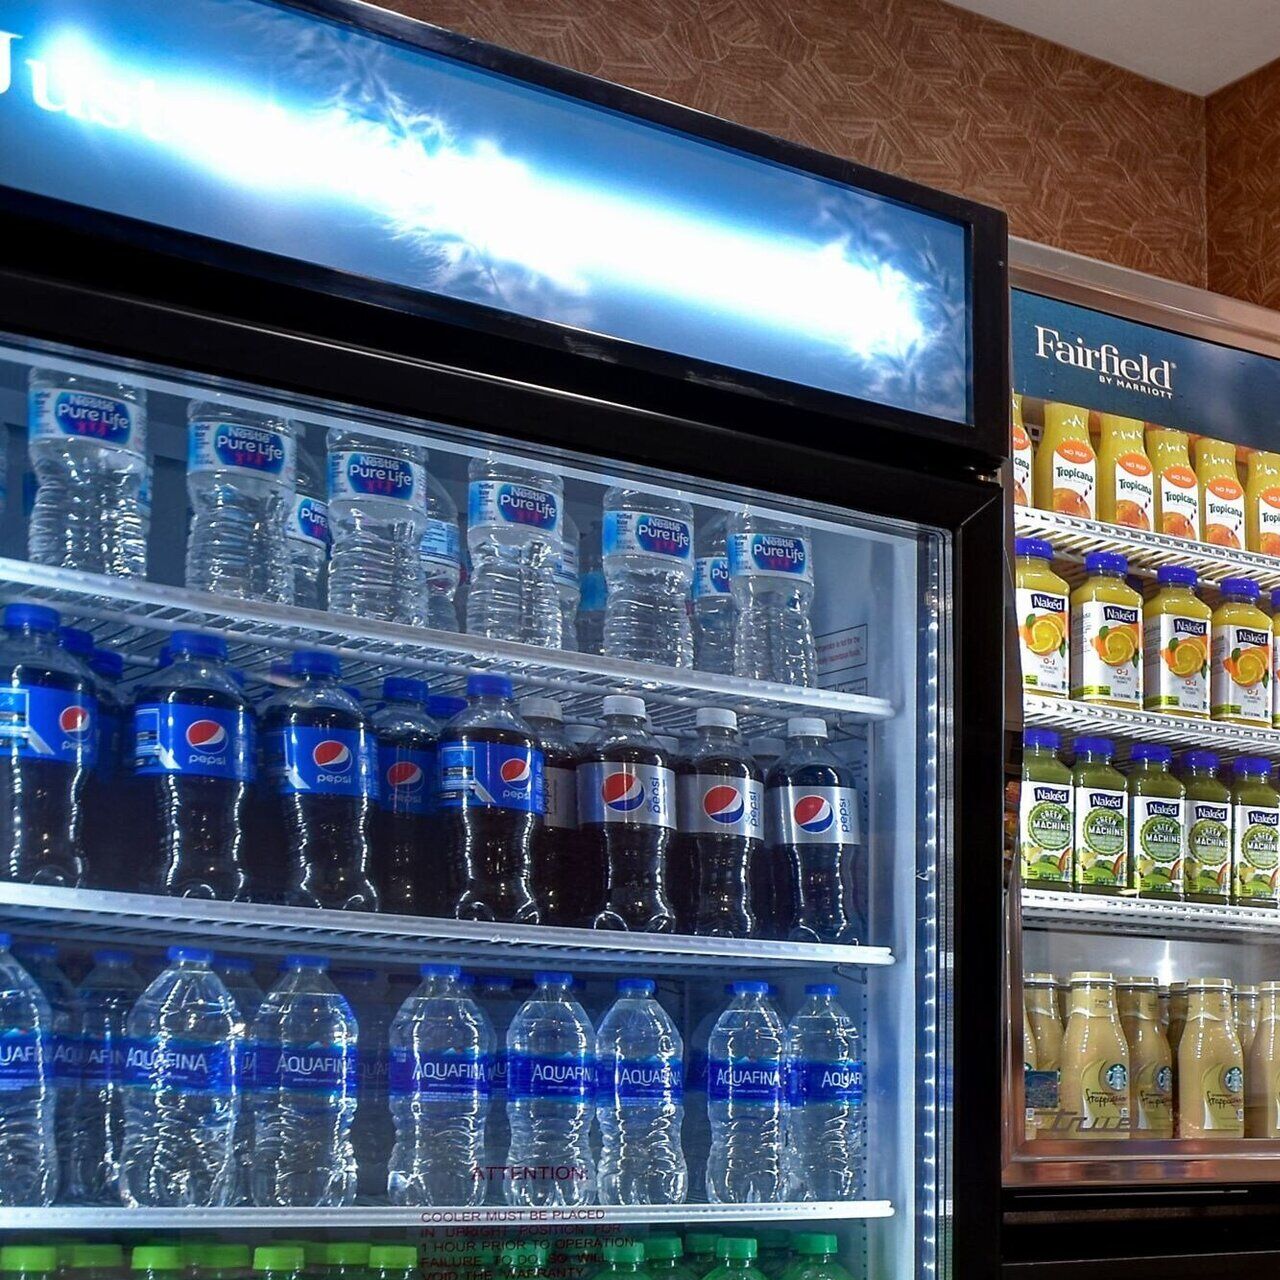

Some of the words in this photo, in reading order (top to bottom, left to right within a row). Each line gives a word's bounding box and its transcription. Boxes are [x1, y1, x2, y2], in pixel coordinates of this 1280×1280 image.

[1035, 325, 1175, 391] Fairfield
[1098, 374, 1113, 385] BY
[1116, 380, 1174, 400] MARRIOTT
[216, 435, 258, 454] Pure
[260, 442, 284, 462] Life
[1056, 466, 1093, 483] Tropicana
[1119, 478, 1152, 495] Tropicana
[501, 492, 534, 513] Pure
[535, 499, 557, 519] Life
[1208, 503, 1243, 518] Tropicana
[639, 524, 670, 543] Pure
[671, 531, 689, 549] Life
[753, 544, 784, 560] Pure
[786, 548, 804, 563] Life
[316, 772, 352, 785] pepsi
[652, 776, 662, 815] pepsi
[750, 791, 759, 827] pepsi
[841, 799, 850, 833] pepsi
[1033, 820, 1071, 832] MACHINE
[1088, 826, 1124, 837] MACHINE
[412, 1061, 485, 1083] AQUAFINA
[716, 1068, 781, 1087] AQUAFINA
[421, 1212, 481, 1223] COOLER
[486, 1211, 523, 1222] MUST
[530, 1211, 547, 1220] BE
[552, 1209, 605, 1219] PLACED
[434, 1242, 475, 1252] HOUR
[482, 1240, 526, 1251] PRIOR
[532, 1240, 550, 1250] TO
